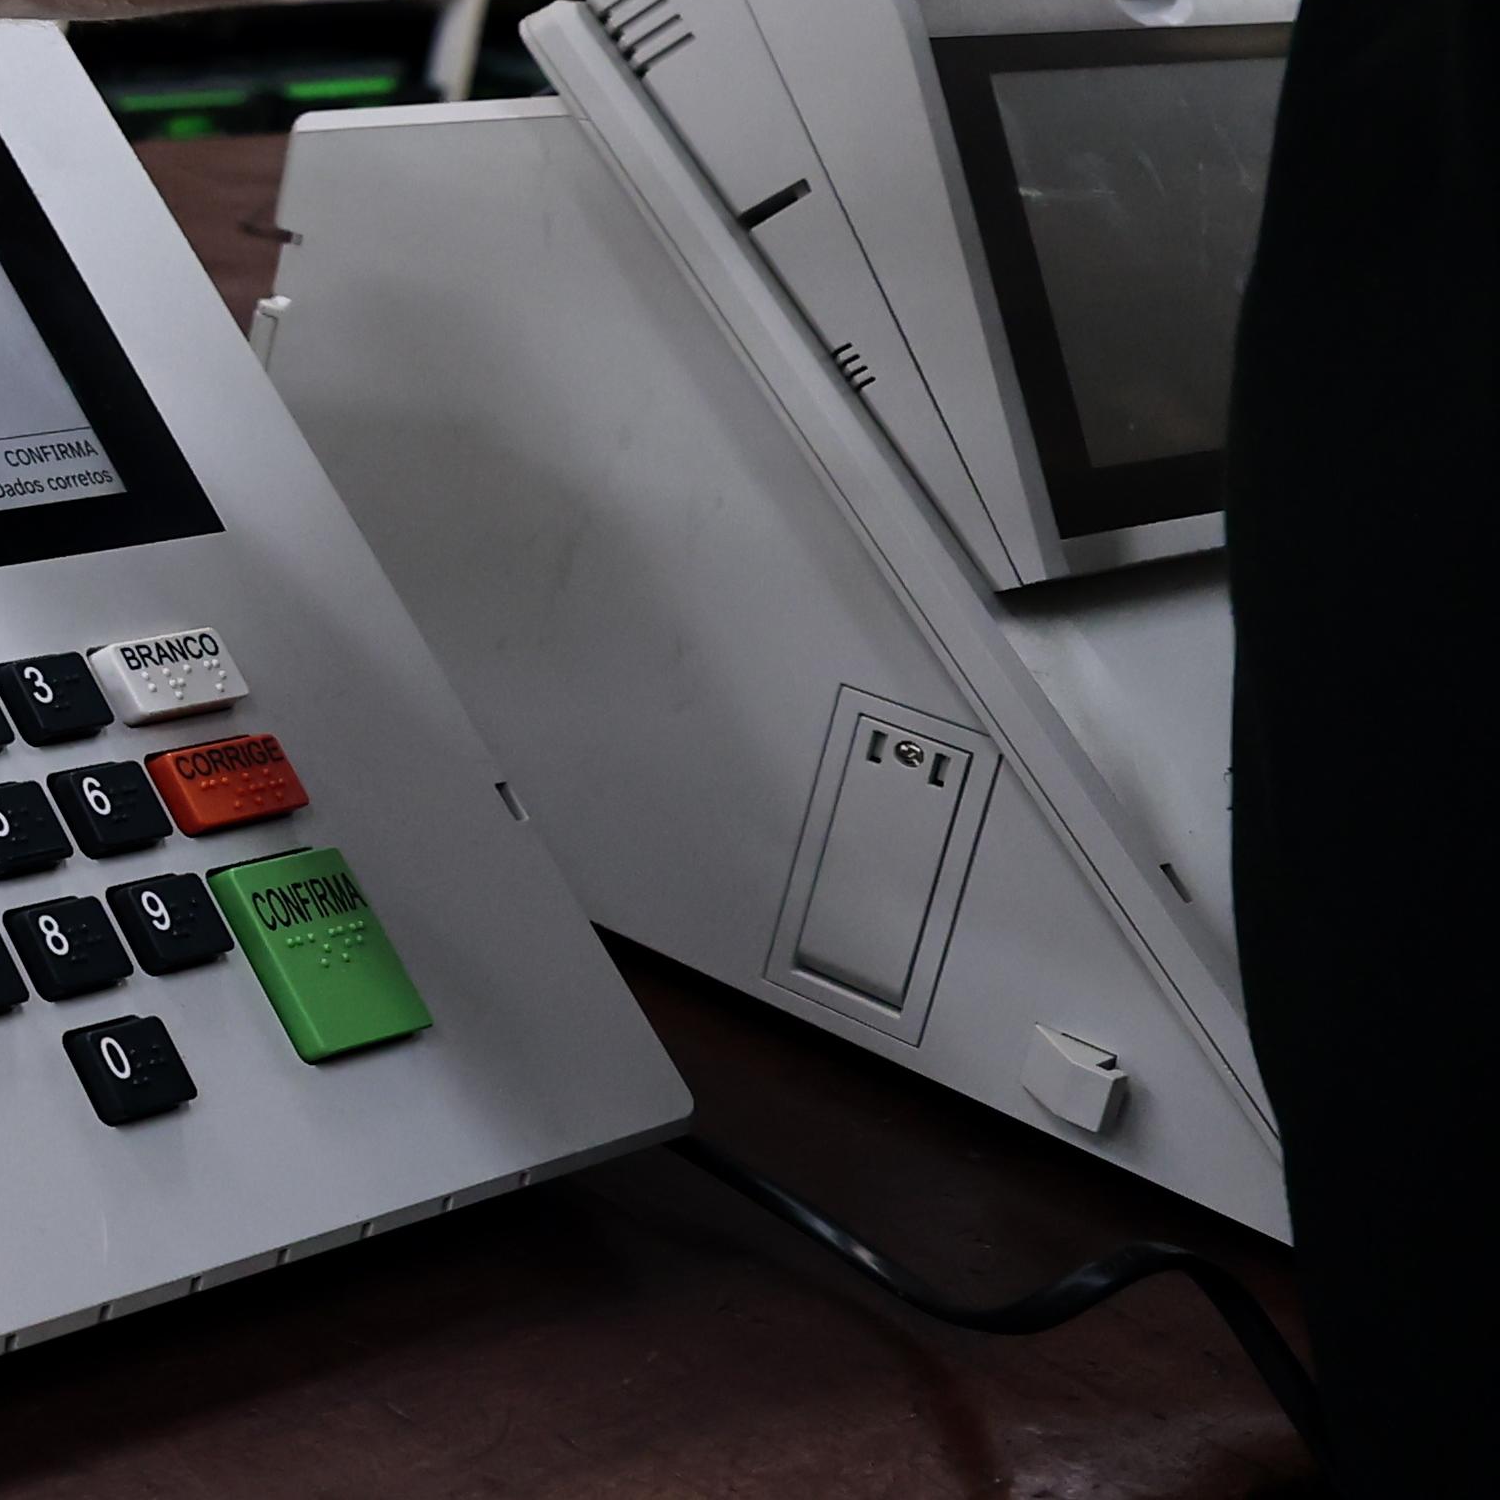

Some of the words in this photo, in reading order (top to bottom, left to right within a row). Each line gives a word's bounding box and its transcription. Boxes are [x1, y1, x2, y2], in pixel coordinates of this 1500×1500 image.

[4, 440, 98, 467] CONFIRMA
[47, 470, 113, 491] corretos
[120, 633, 220, 671] BRANCO
[24, 667, 53, 703] 3
[174, 737, 285, 781] CORRIGE
[83, 777, 111, 815] 6
[142, 891, 170, 930] 9
[251, 872, 368, 932] CONFIRMA
[39, 915, 68, 955] 8
[101, 1037, 130, 1079] 0
